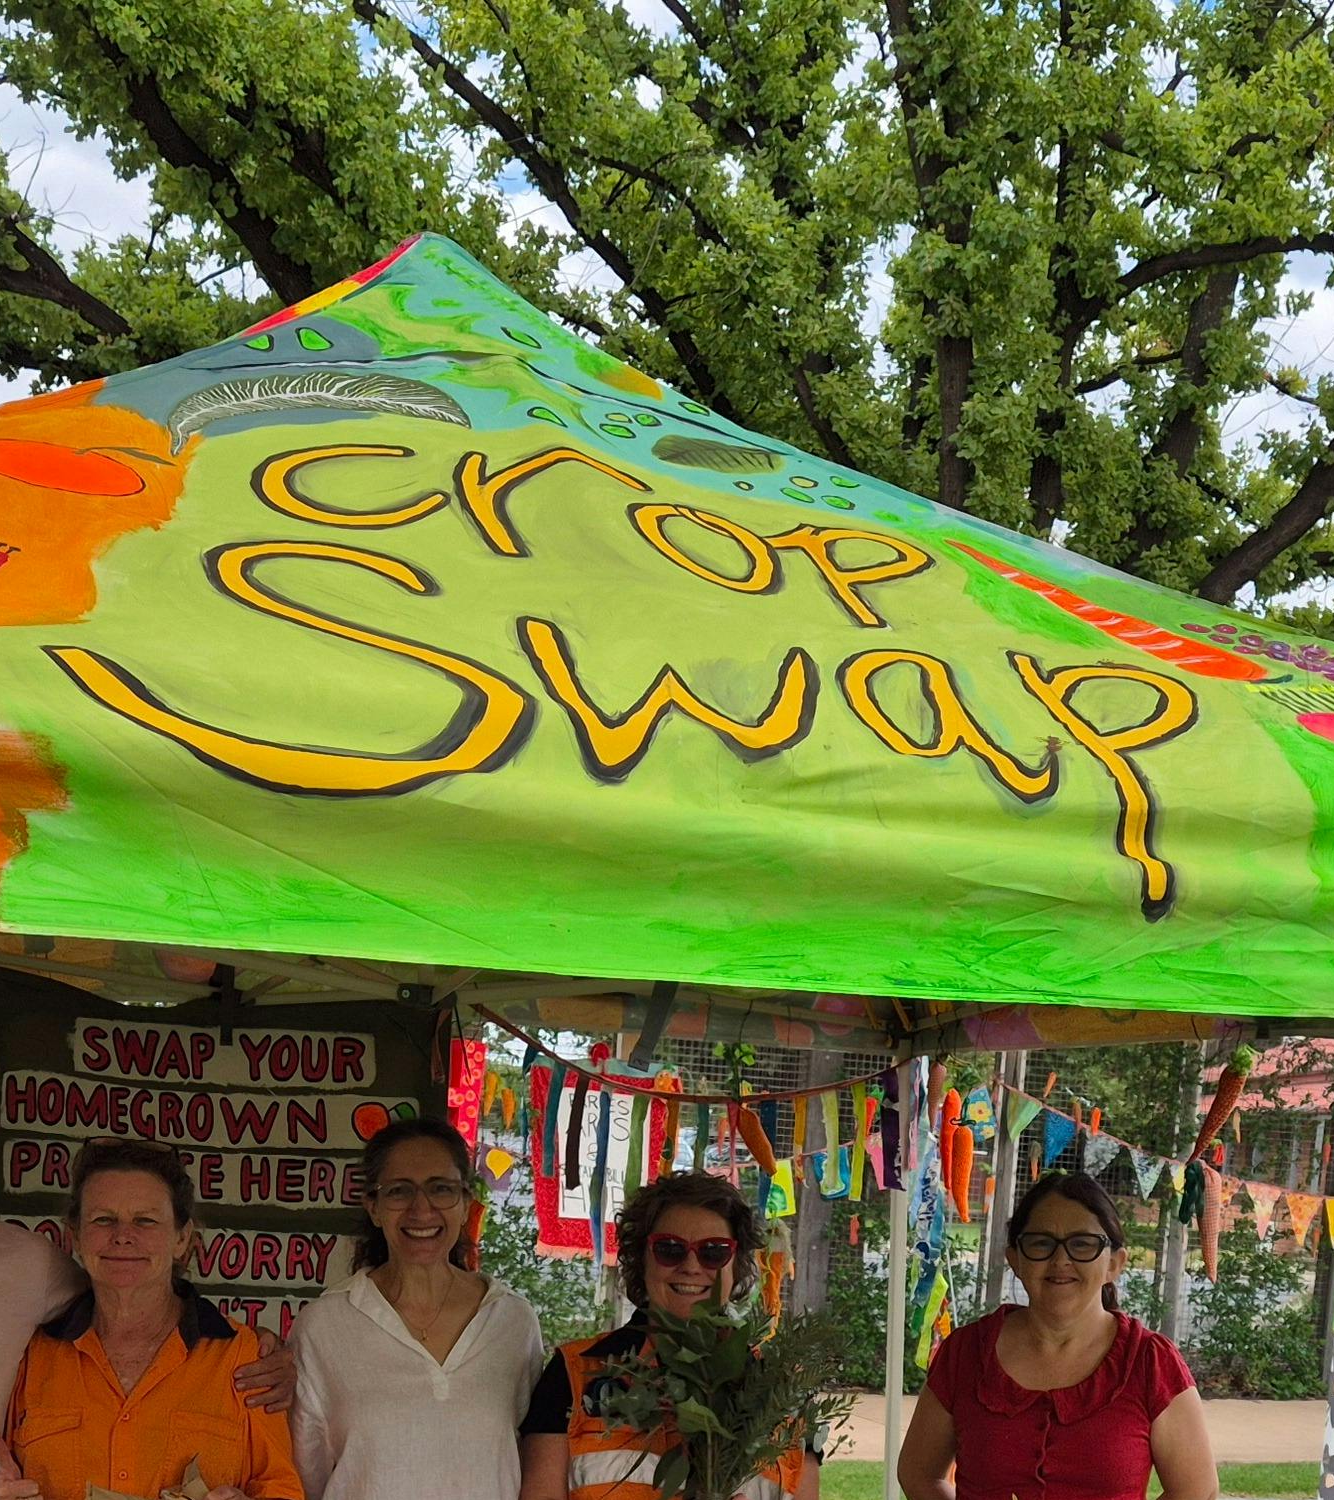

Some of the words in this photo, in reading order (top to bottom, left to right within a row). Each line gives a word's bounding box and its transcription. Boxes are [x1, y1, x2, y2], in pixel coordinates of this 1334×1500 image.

[43, 541, 1199, 922] Swap
[81, 1025, 216, 1080] SWAP
[240, 1033, 367, 1083] YOUR
[5, 1074, 328, 1144] HOMEGROWN
[240, 1156, 367, 1207] HERE
